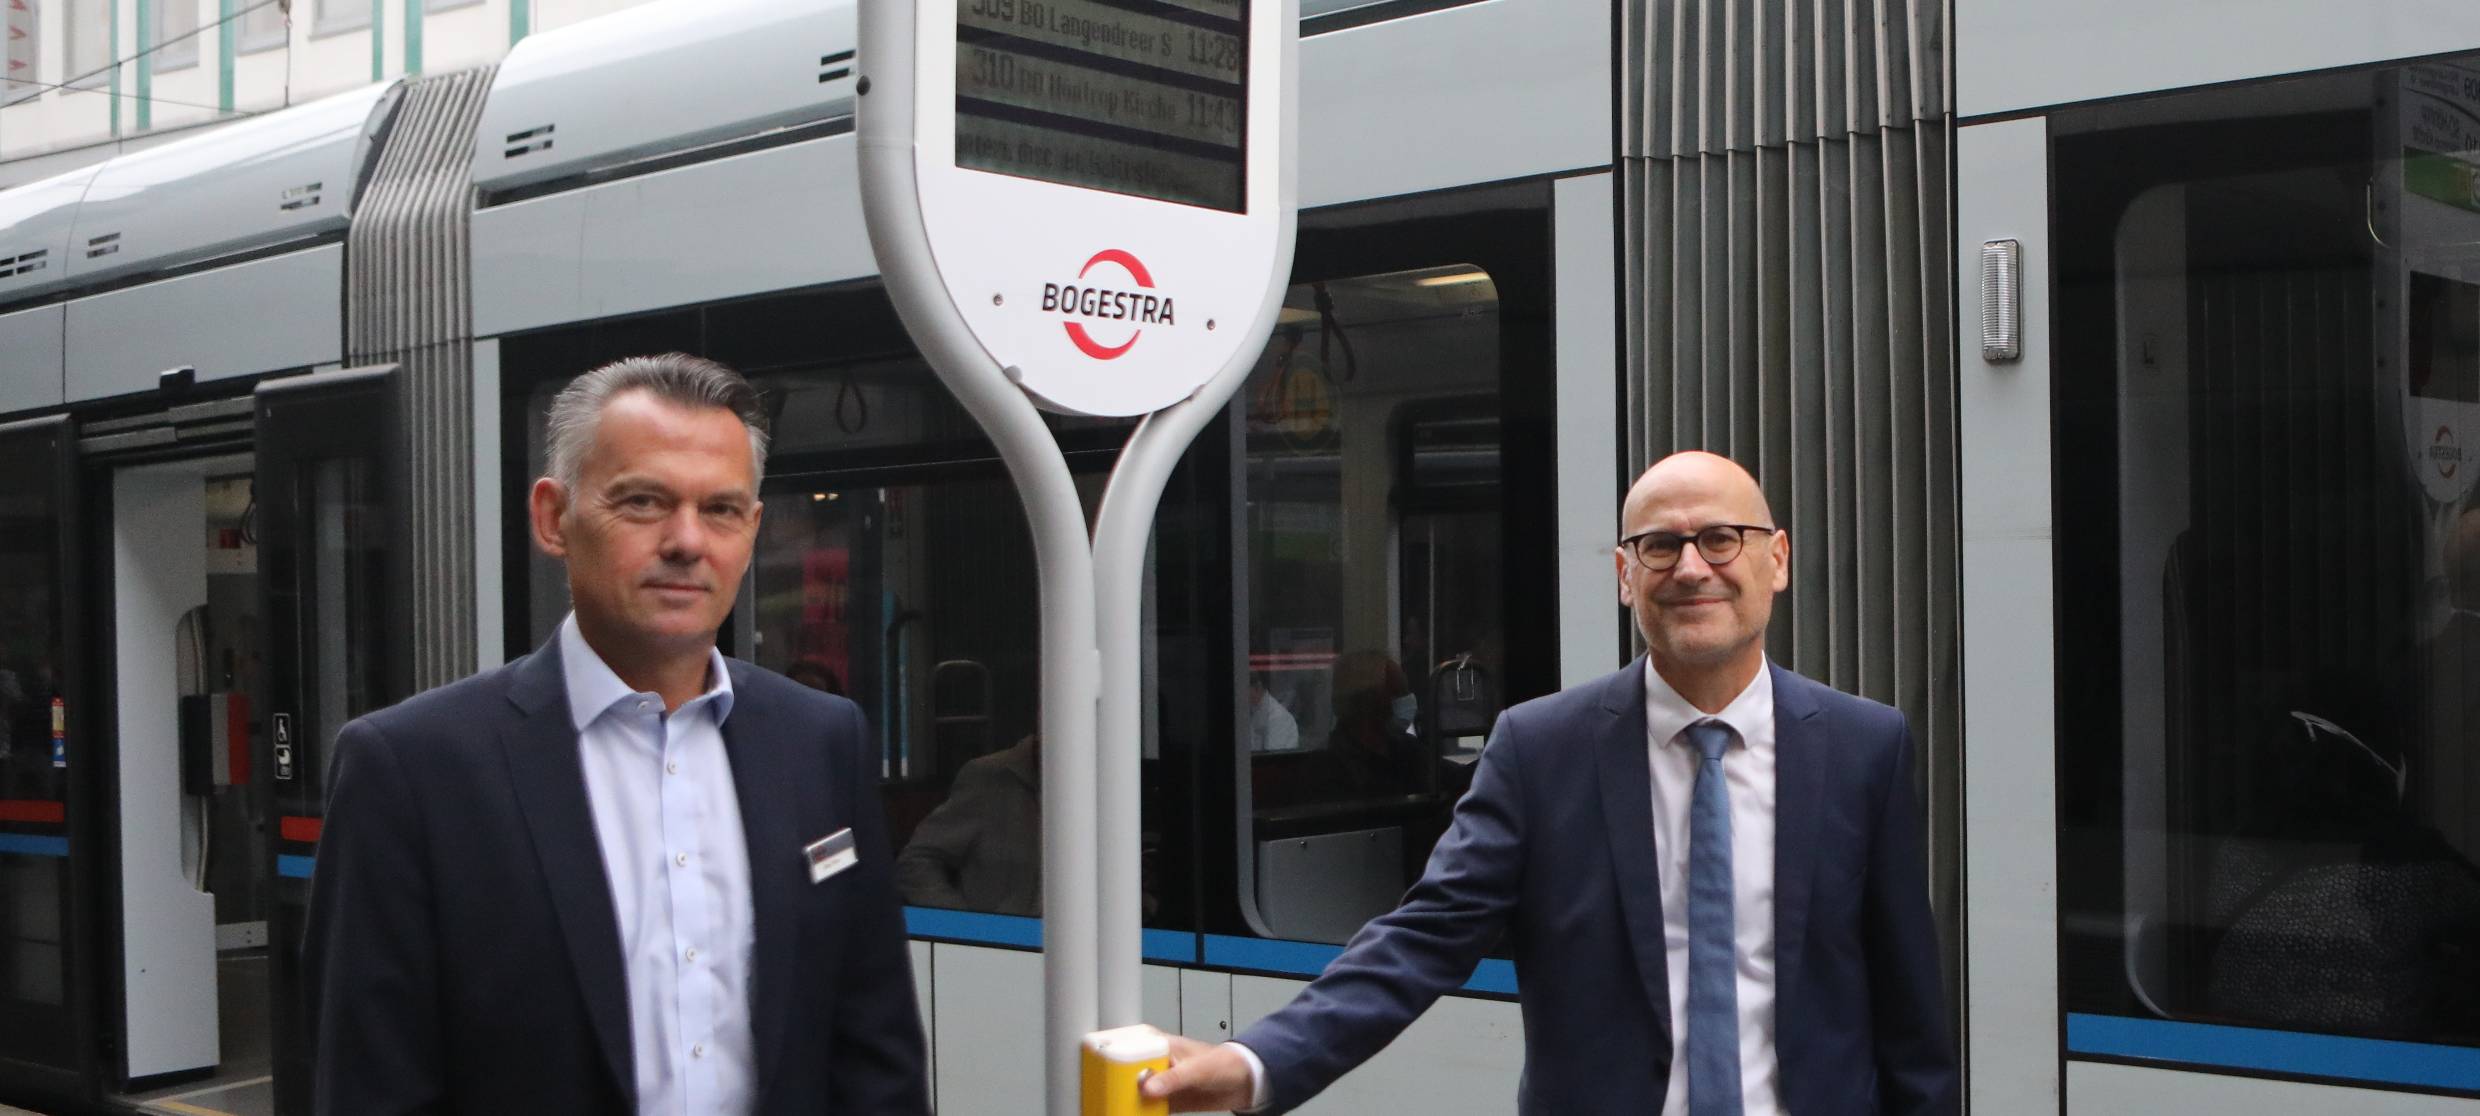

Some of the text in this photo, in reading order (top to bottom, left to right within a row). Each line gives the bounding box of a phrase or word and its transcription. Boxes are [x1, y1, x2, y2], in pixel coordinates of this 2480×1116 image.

[1020, 0, 1043, 29] BO
[1049, 6, 1154, 53] Langendreer
[1161, 31, 1172, 57] S
[1187, 29, 1238, 72] 11:28
[973, 48, 1015, 92] 310
[1042, 282, 1175, 326] BOGESTRA
